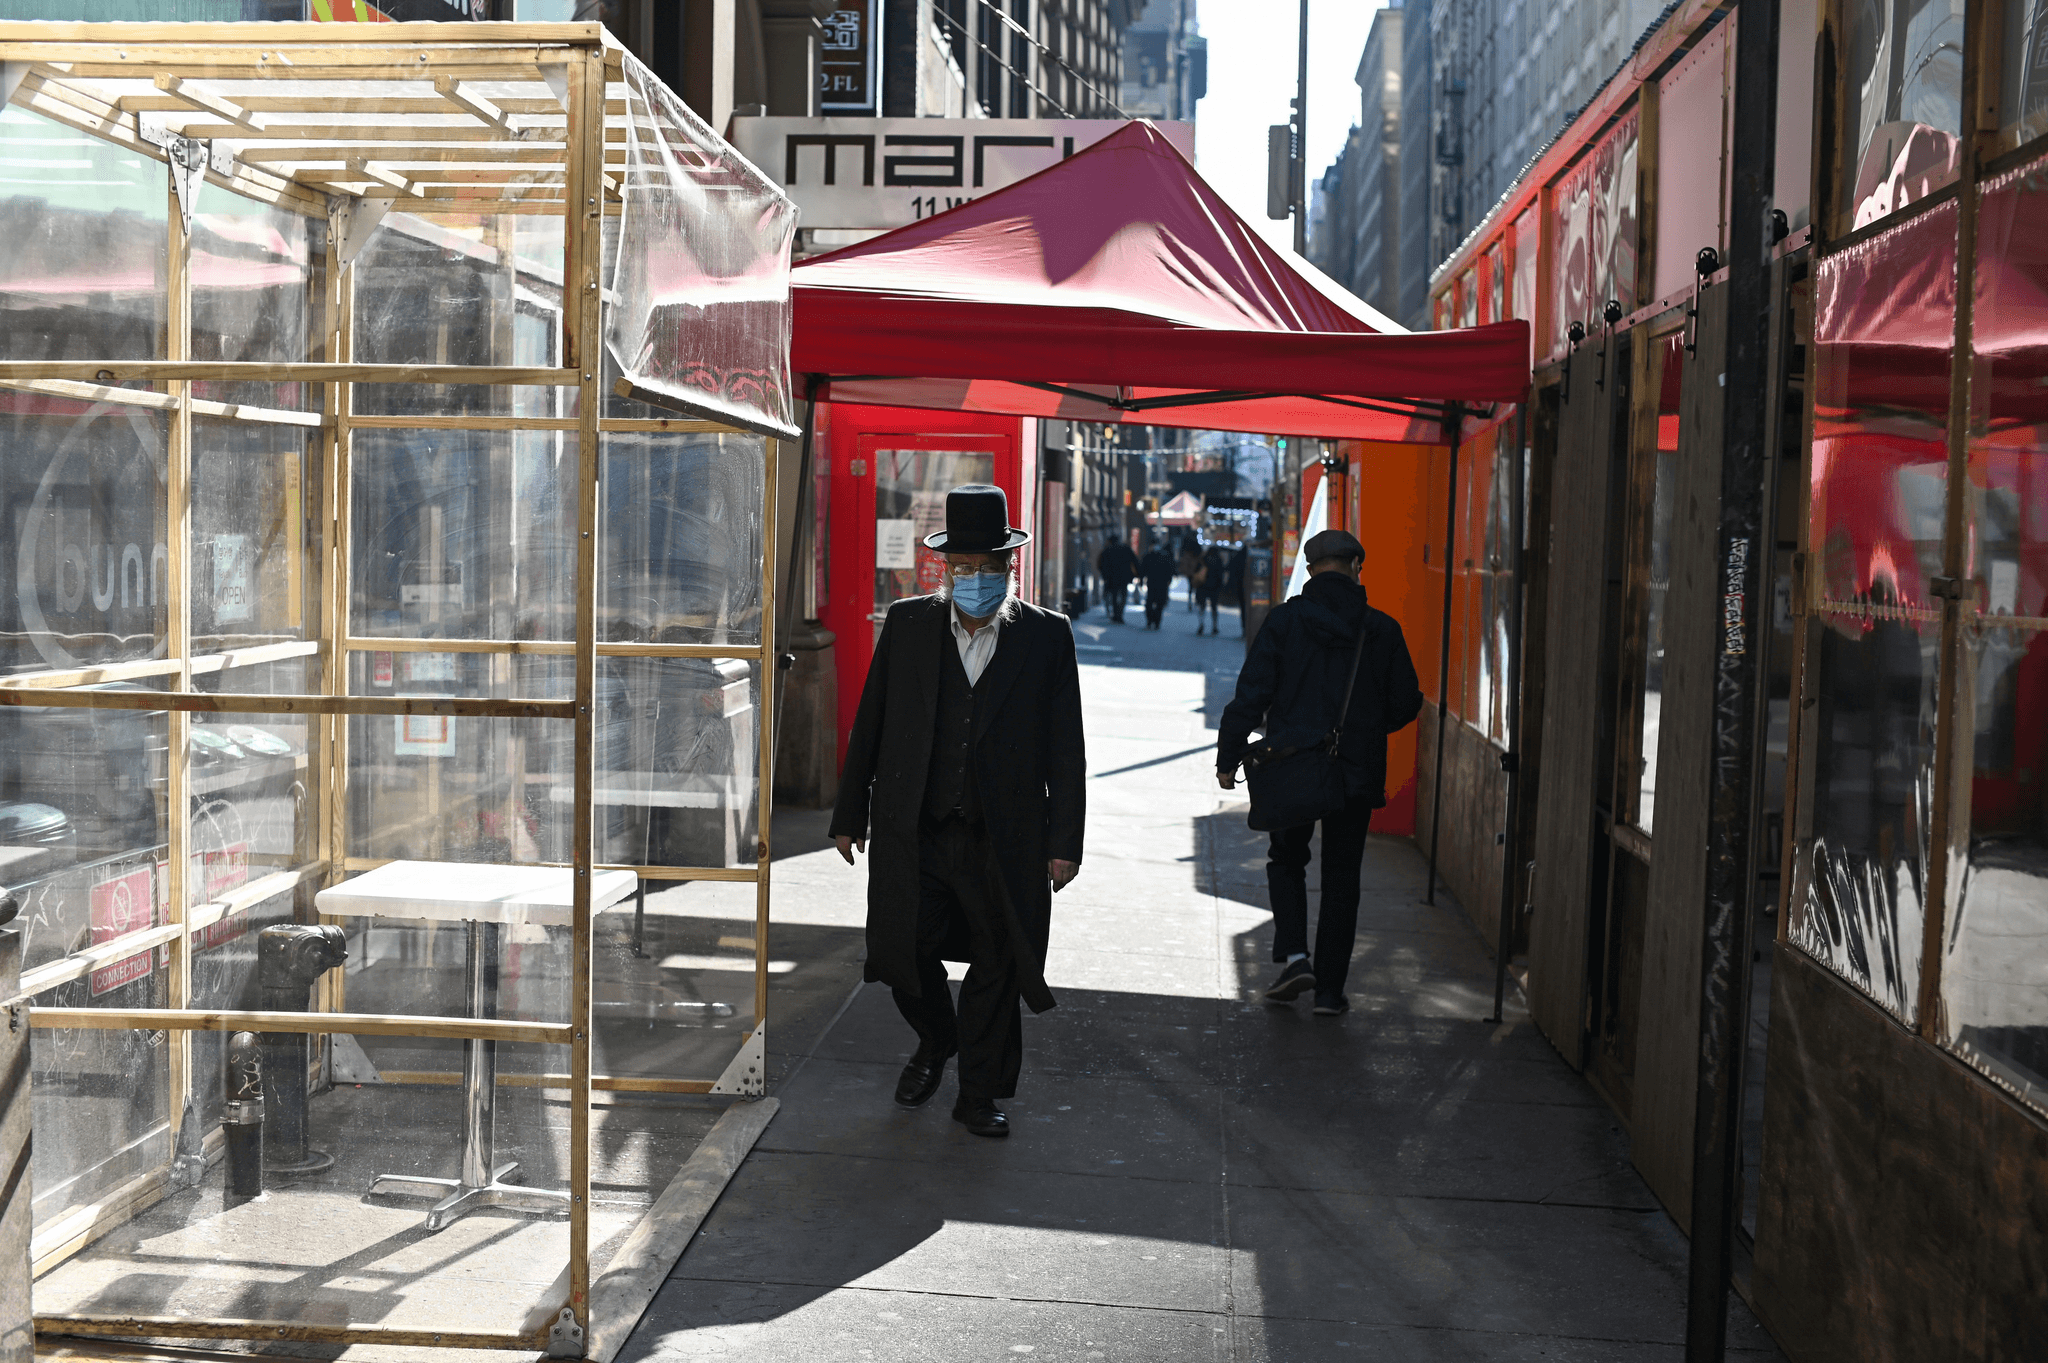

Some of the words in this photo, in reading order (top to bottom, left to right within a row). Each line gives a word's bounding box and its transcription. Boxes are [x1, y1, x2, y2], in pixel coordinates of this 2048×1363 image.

[834, 75, 859, 91] FL
[911, 196, 936, 219] 11
[222, 586, 246, 605] OPEN
[95, 957, 148, 989] CONNECTION
